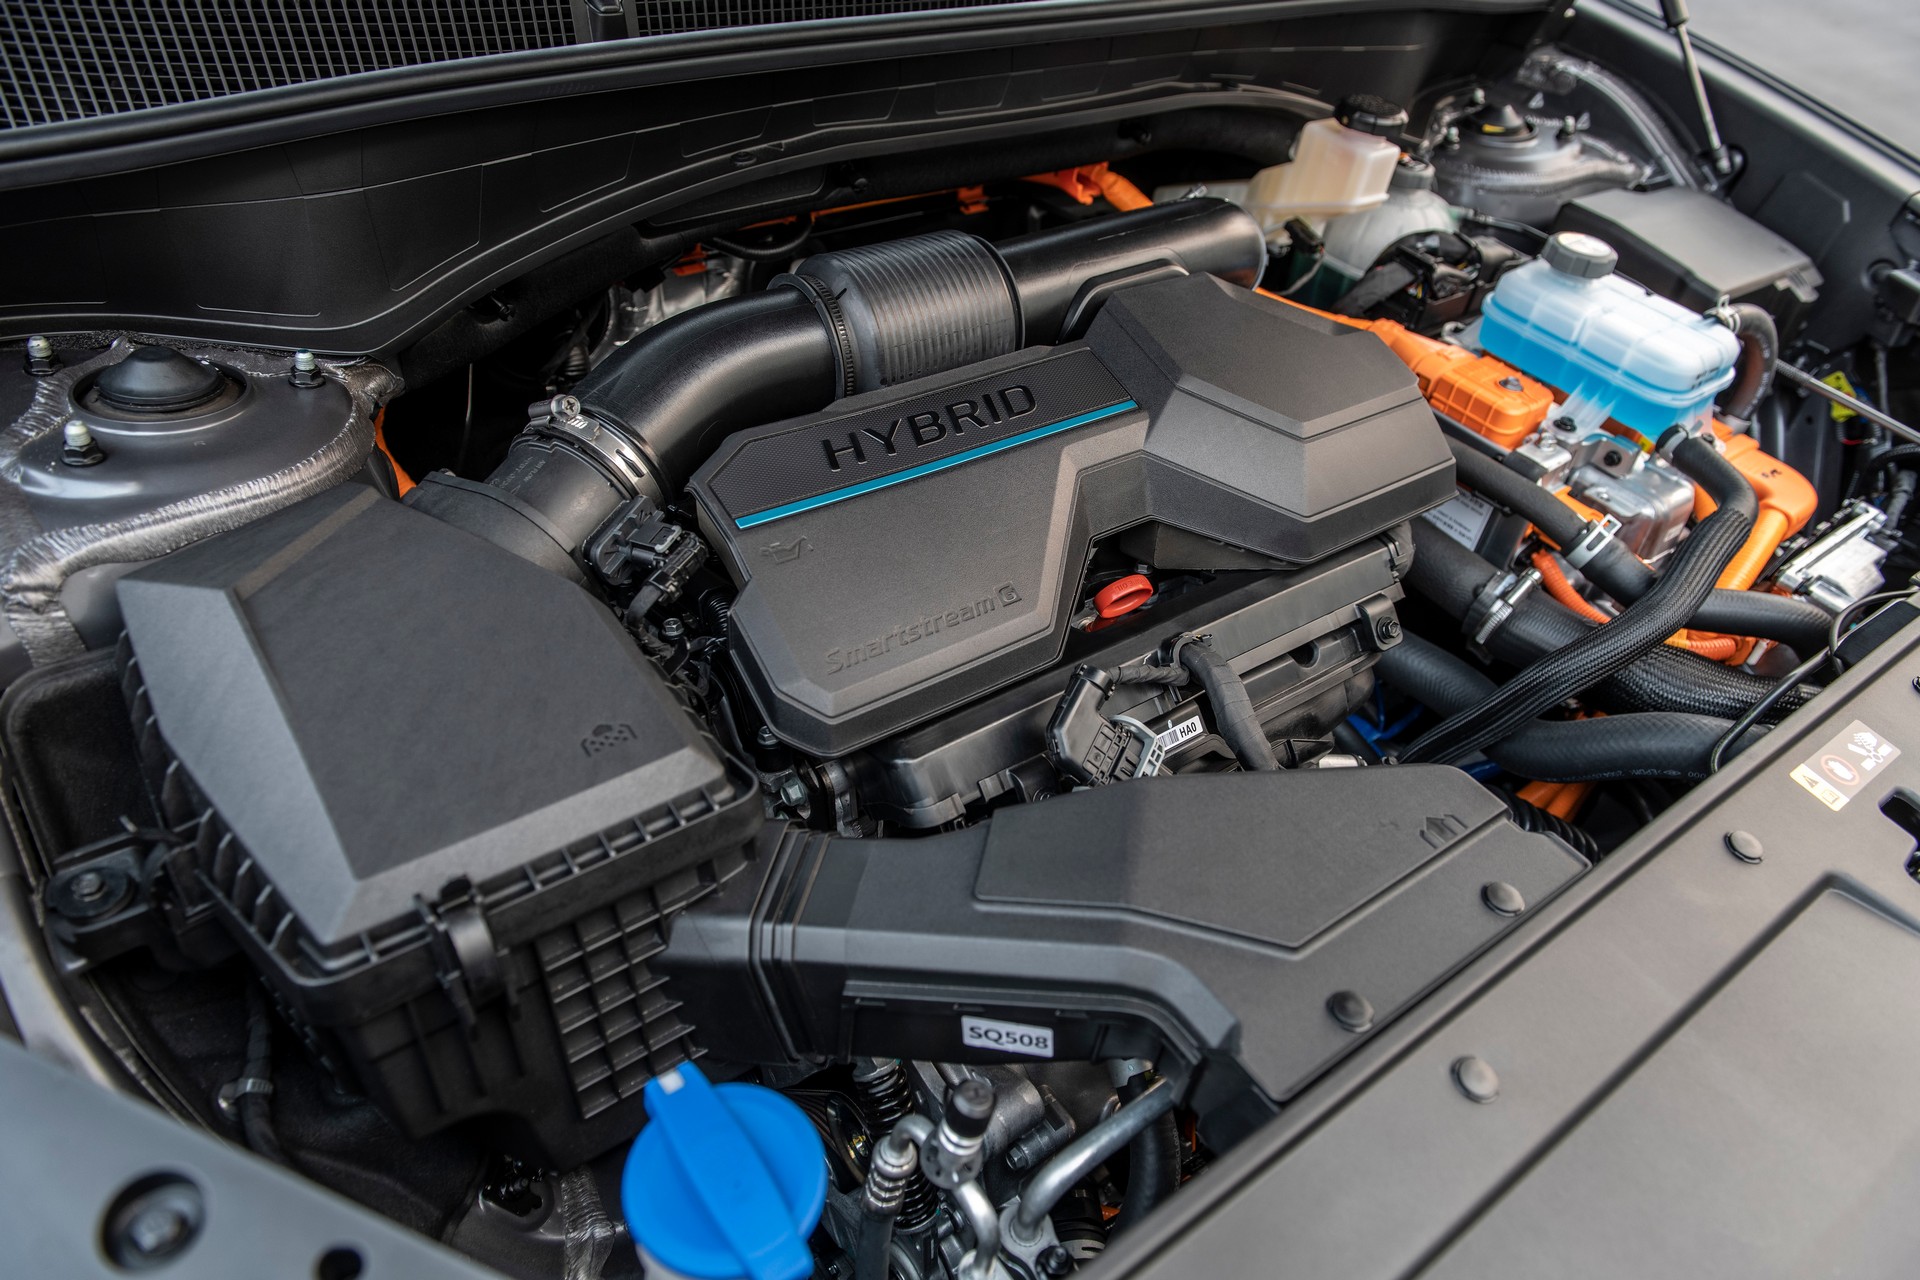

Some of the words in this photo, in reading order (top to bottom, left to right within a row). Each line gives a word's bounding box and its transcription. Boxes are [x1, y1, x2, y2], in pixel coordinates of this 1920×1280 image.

[821, 384, 1036, 472] HYBRID
[824, 596, 996, 675] Smartstream
[997, 581, 1022, 608] G
[969, 1026, 1048, 1049] SQ508
